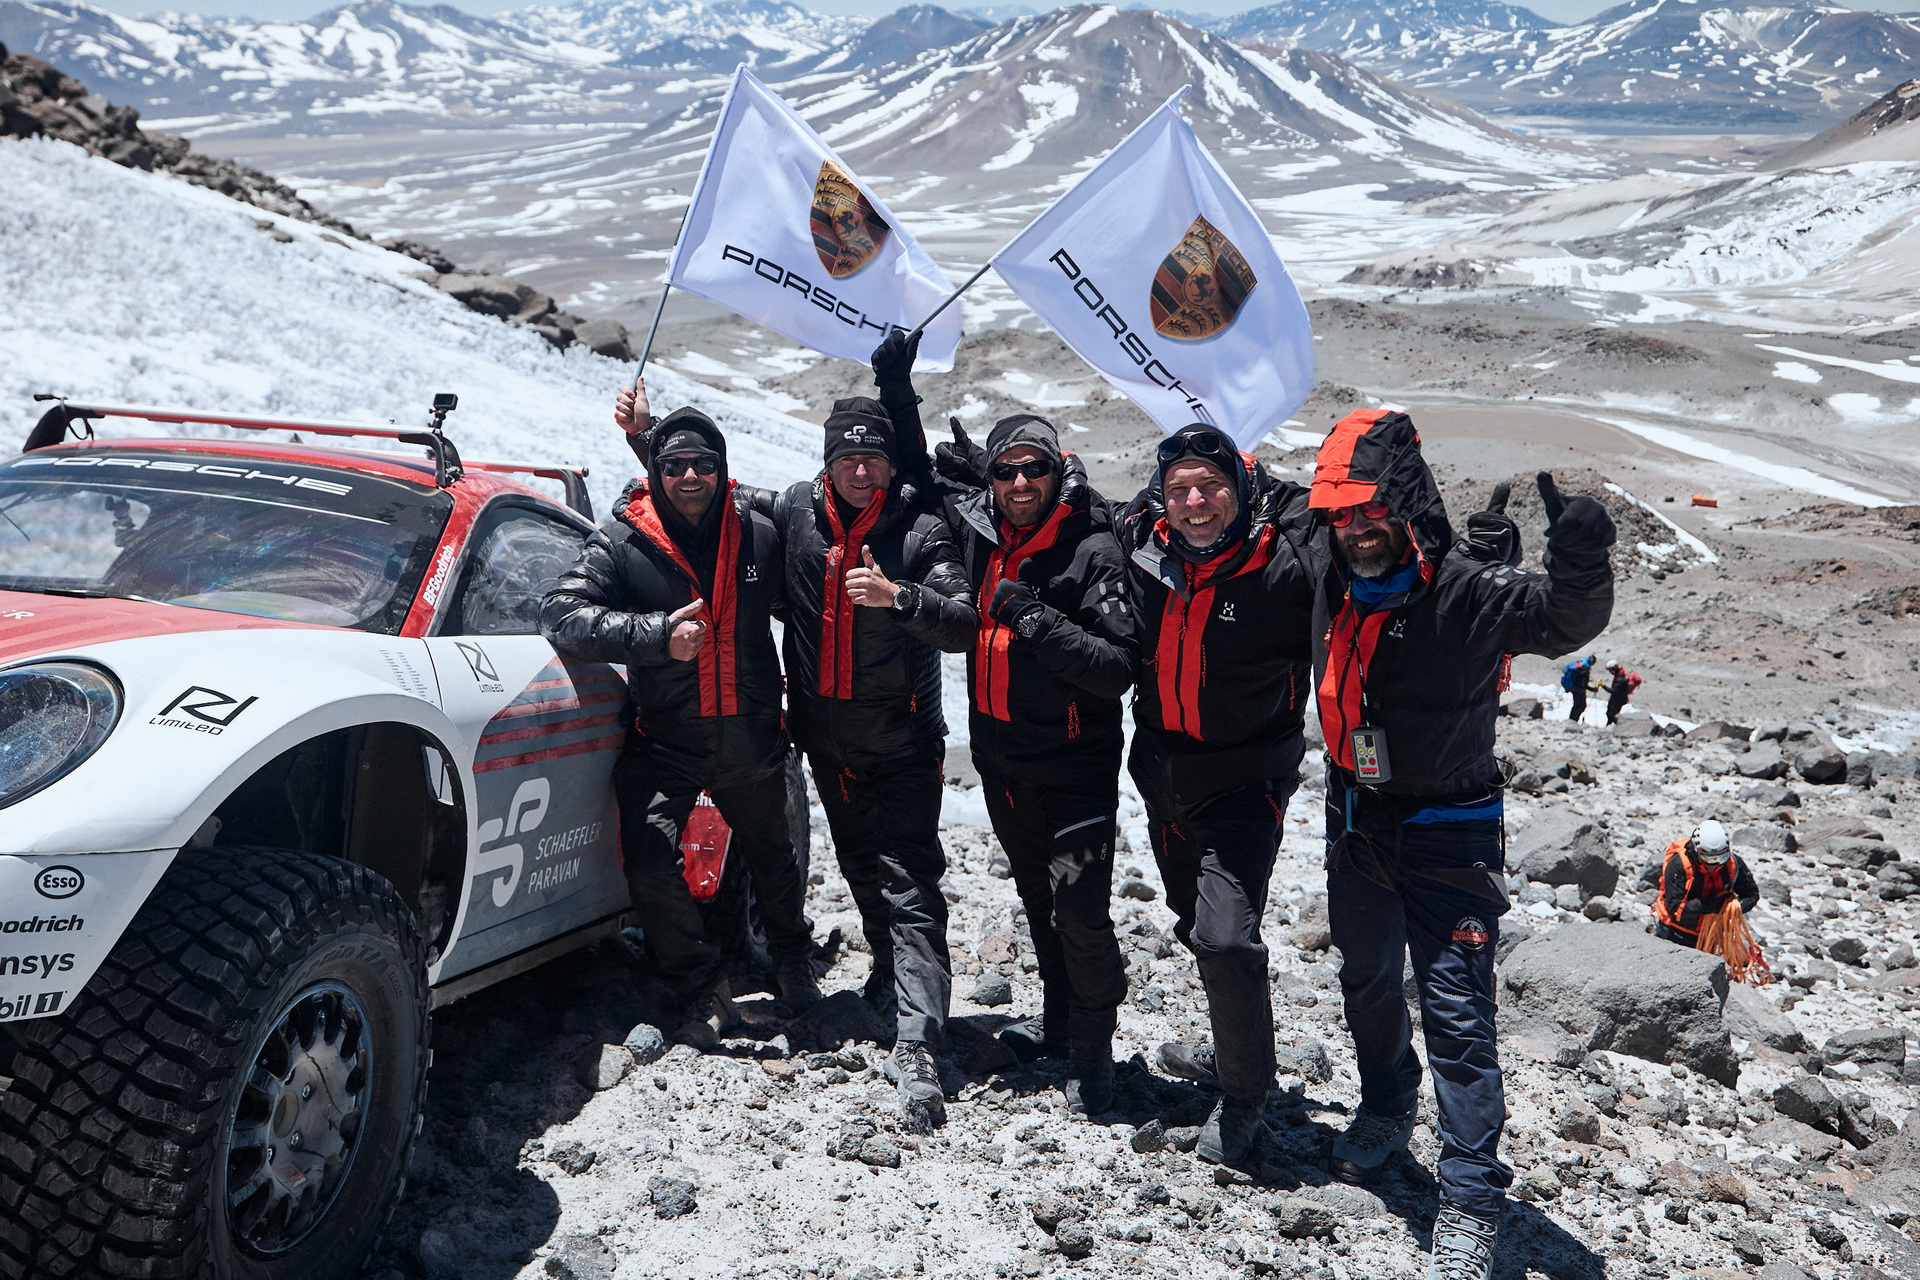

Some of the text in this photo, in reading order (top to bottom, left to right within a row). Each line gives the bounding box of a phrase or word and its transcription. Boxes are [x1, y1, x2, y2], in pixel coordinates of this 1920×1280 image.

[10, 457, 354, 497] PORSCHE
[422, 544, 455, 607] BFGoodrich
[535, 821, 603, 861] SCHAEFFLER
[42, 874, 78, 889] Esso
[528, 857, 581, 895] PARAVAN
[0, 914, 84, 933] odrich
